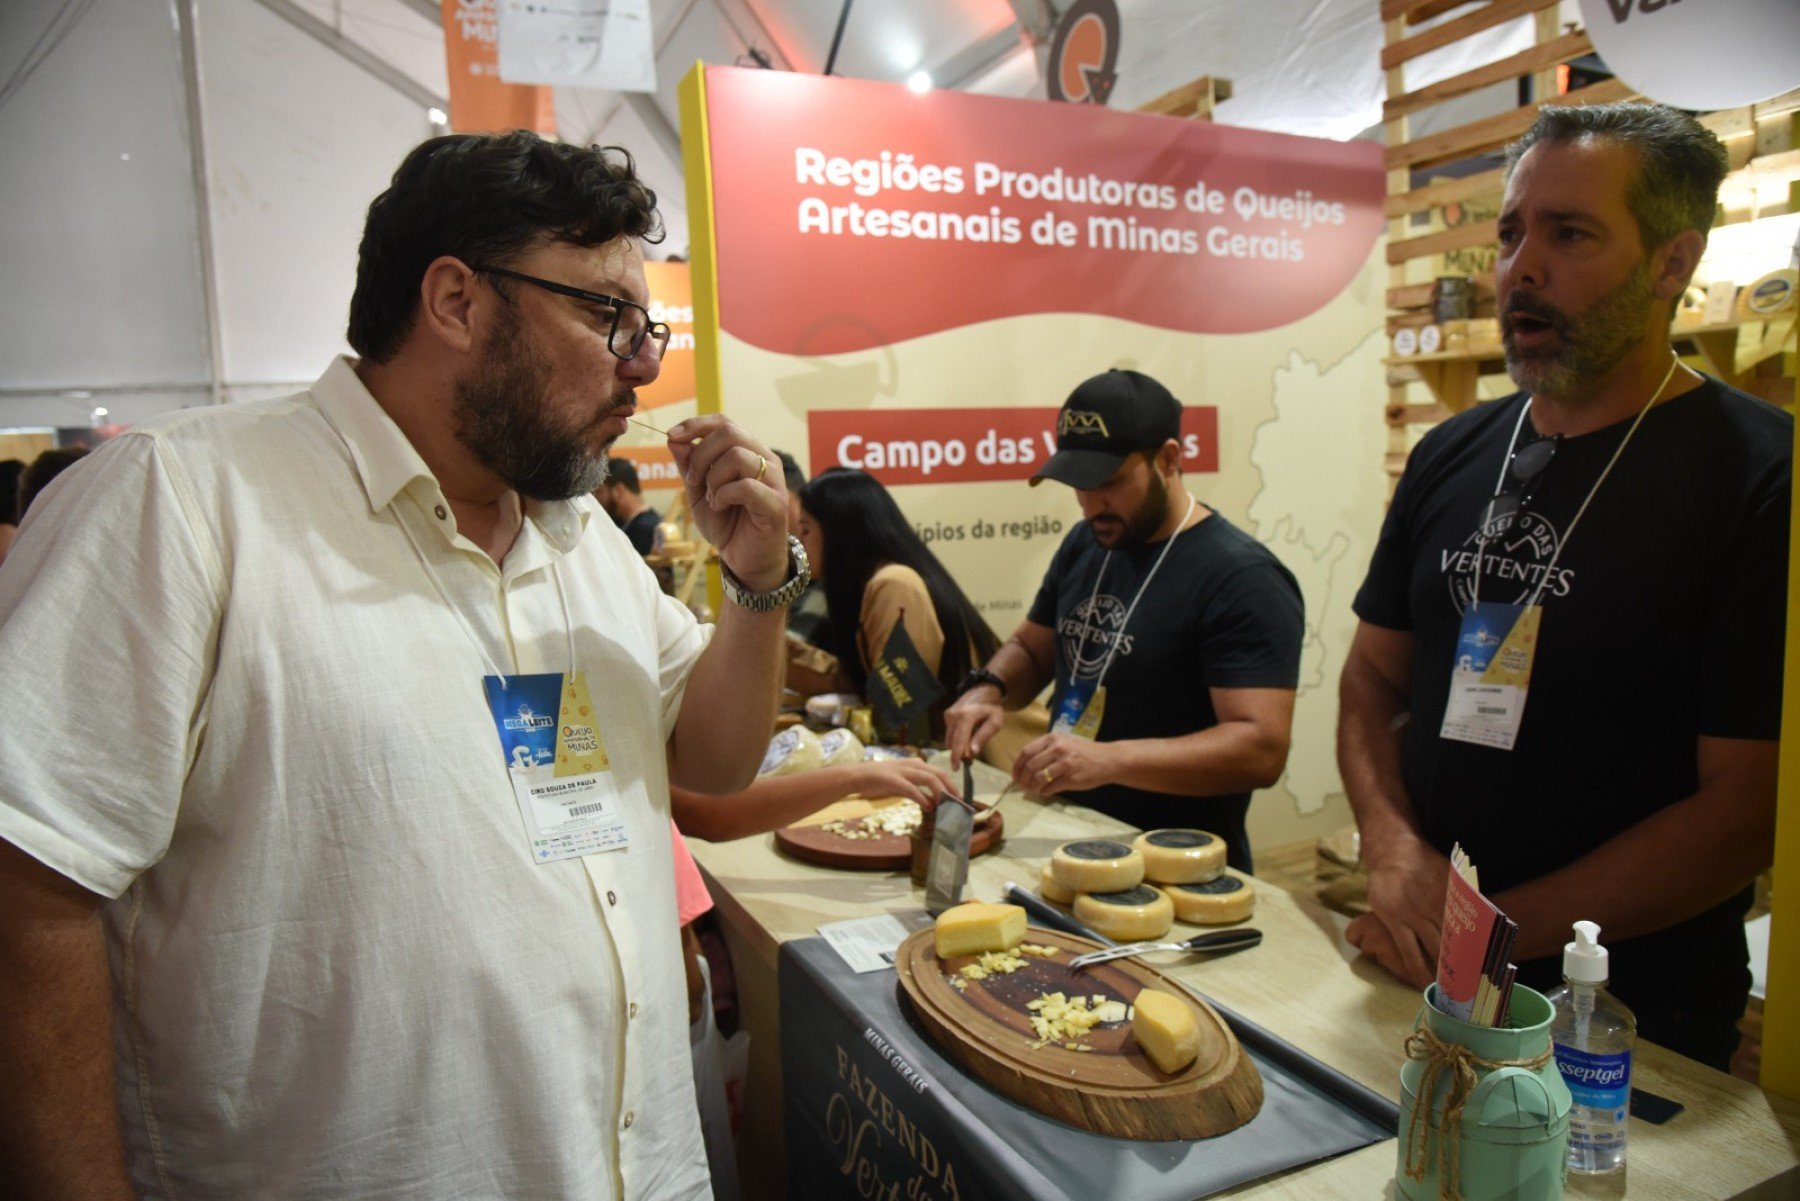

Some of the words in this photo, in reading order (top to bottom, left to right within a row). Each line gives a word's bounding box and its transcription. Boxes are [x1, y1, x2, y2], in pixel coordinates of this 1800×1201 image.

[794, 148, 965, 196] Regiões
[975, 162, 1176, 208] Produtoras
[1184, 181, 1225, 214] de
[1233, 187, 1346, 228] Queijos
[798, 197, 1022, 244] Artesanais
[1030, 212, 1077, 247] de
[1088, 216, 1199, 253] Minas
[1206, 226, 1304, 262] Gerais
[836, 433, 967, 475] Campo
[976, 429, 1036, 464] das
[914, 521, 965, 543] ípios
[971, 518, 996, 539] da
[1001, 515, 1063, 540] região
[1441, 548, 1576, 597] VERTENTES
[863, 1027, 893, 1061] MINAS
[890, 1055, 930, 1095] GERAIS
[1556, 1060, 1626, 1085] sseptgel
[836, 1044, 960, 1201] FAZENDA
